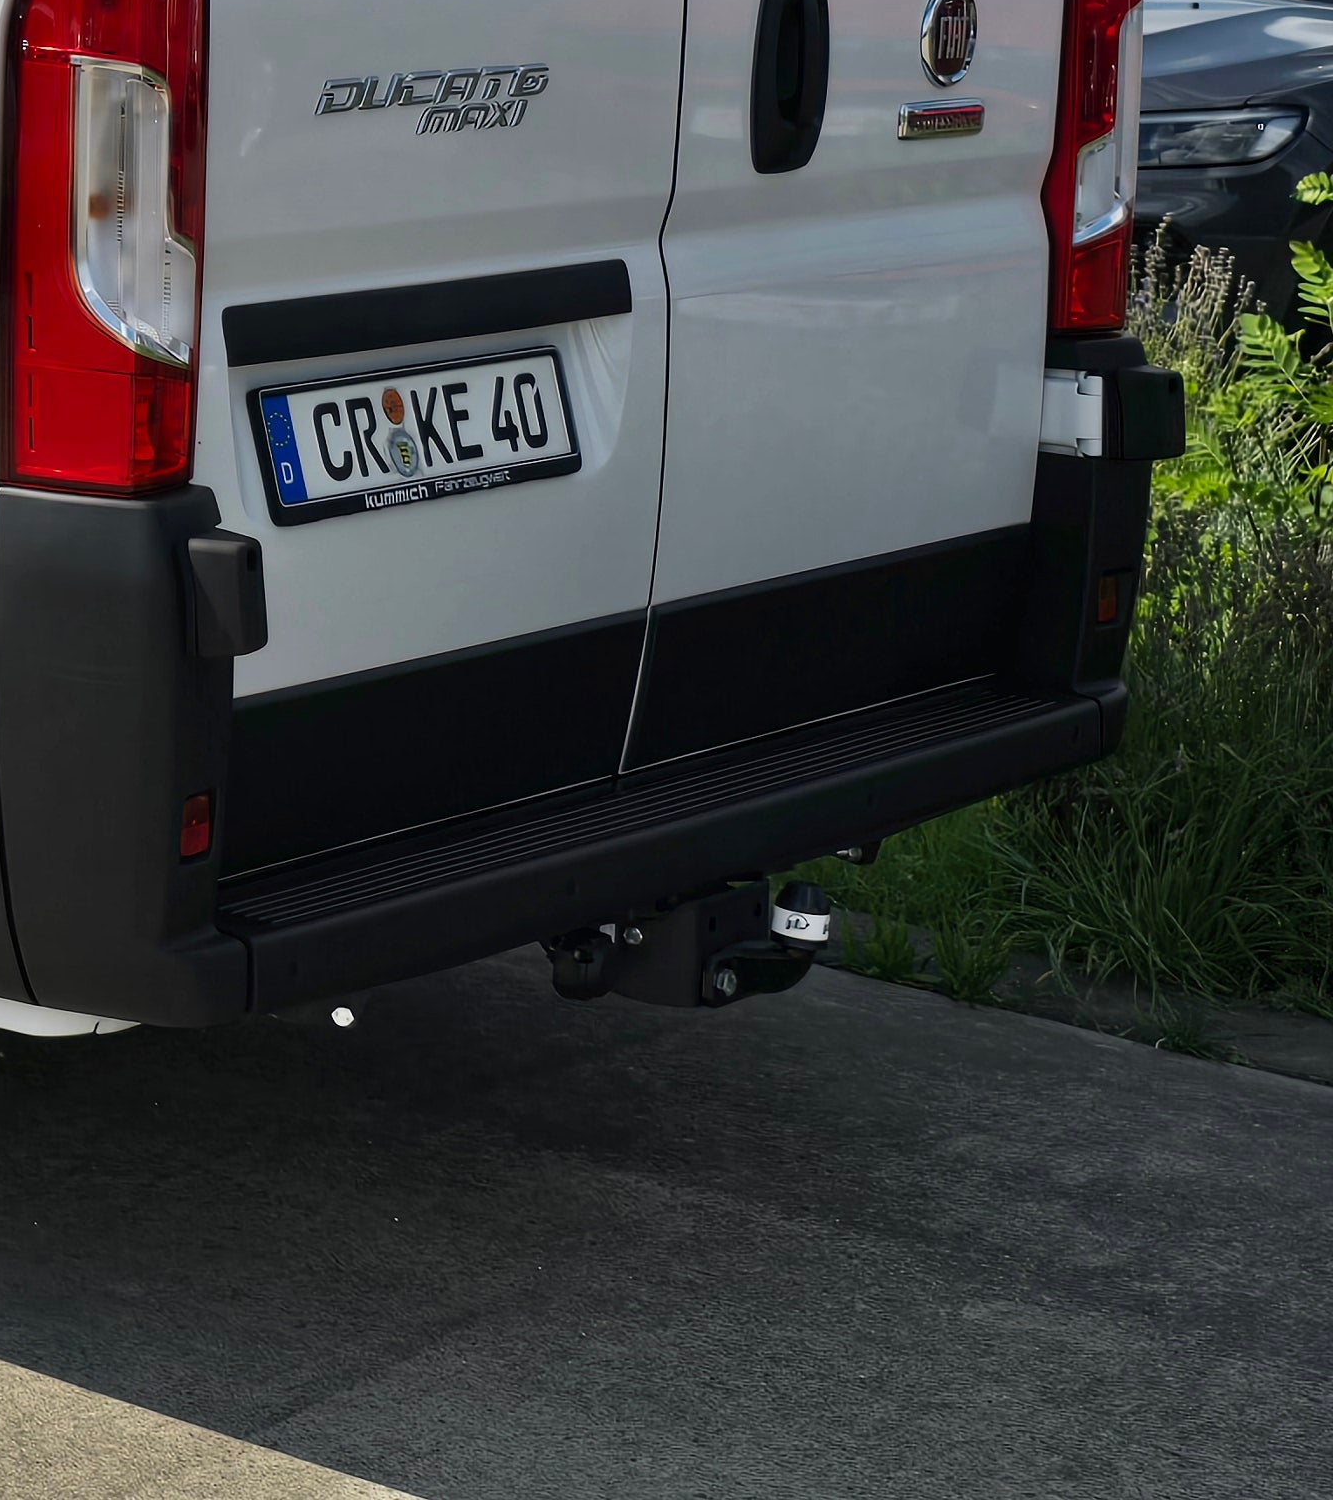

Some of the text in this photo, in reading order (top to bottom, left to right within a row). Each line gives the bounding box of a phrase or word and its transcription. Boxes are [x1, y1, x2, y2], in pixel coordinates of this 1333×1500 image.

[314, 62, 549, 116] DUCATO
[415, 99, 528, 135] MAXI
[312, 372, 549, 482] CR KE 40
[280, 461, 294, 485] D
